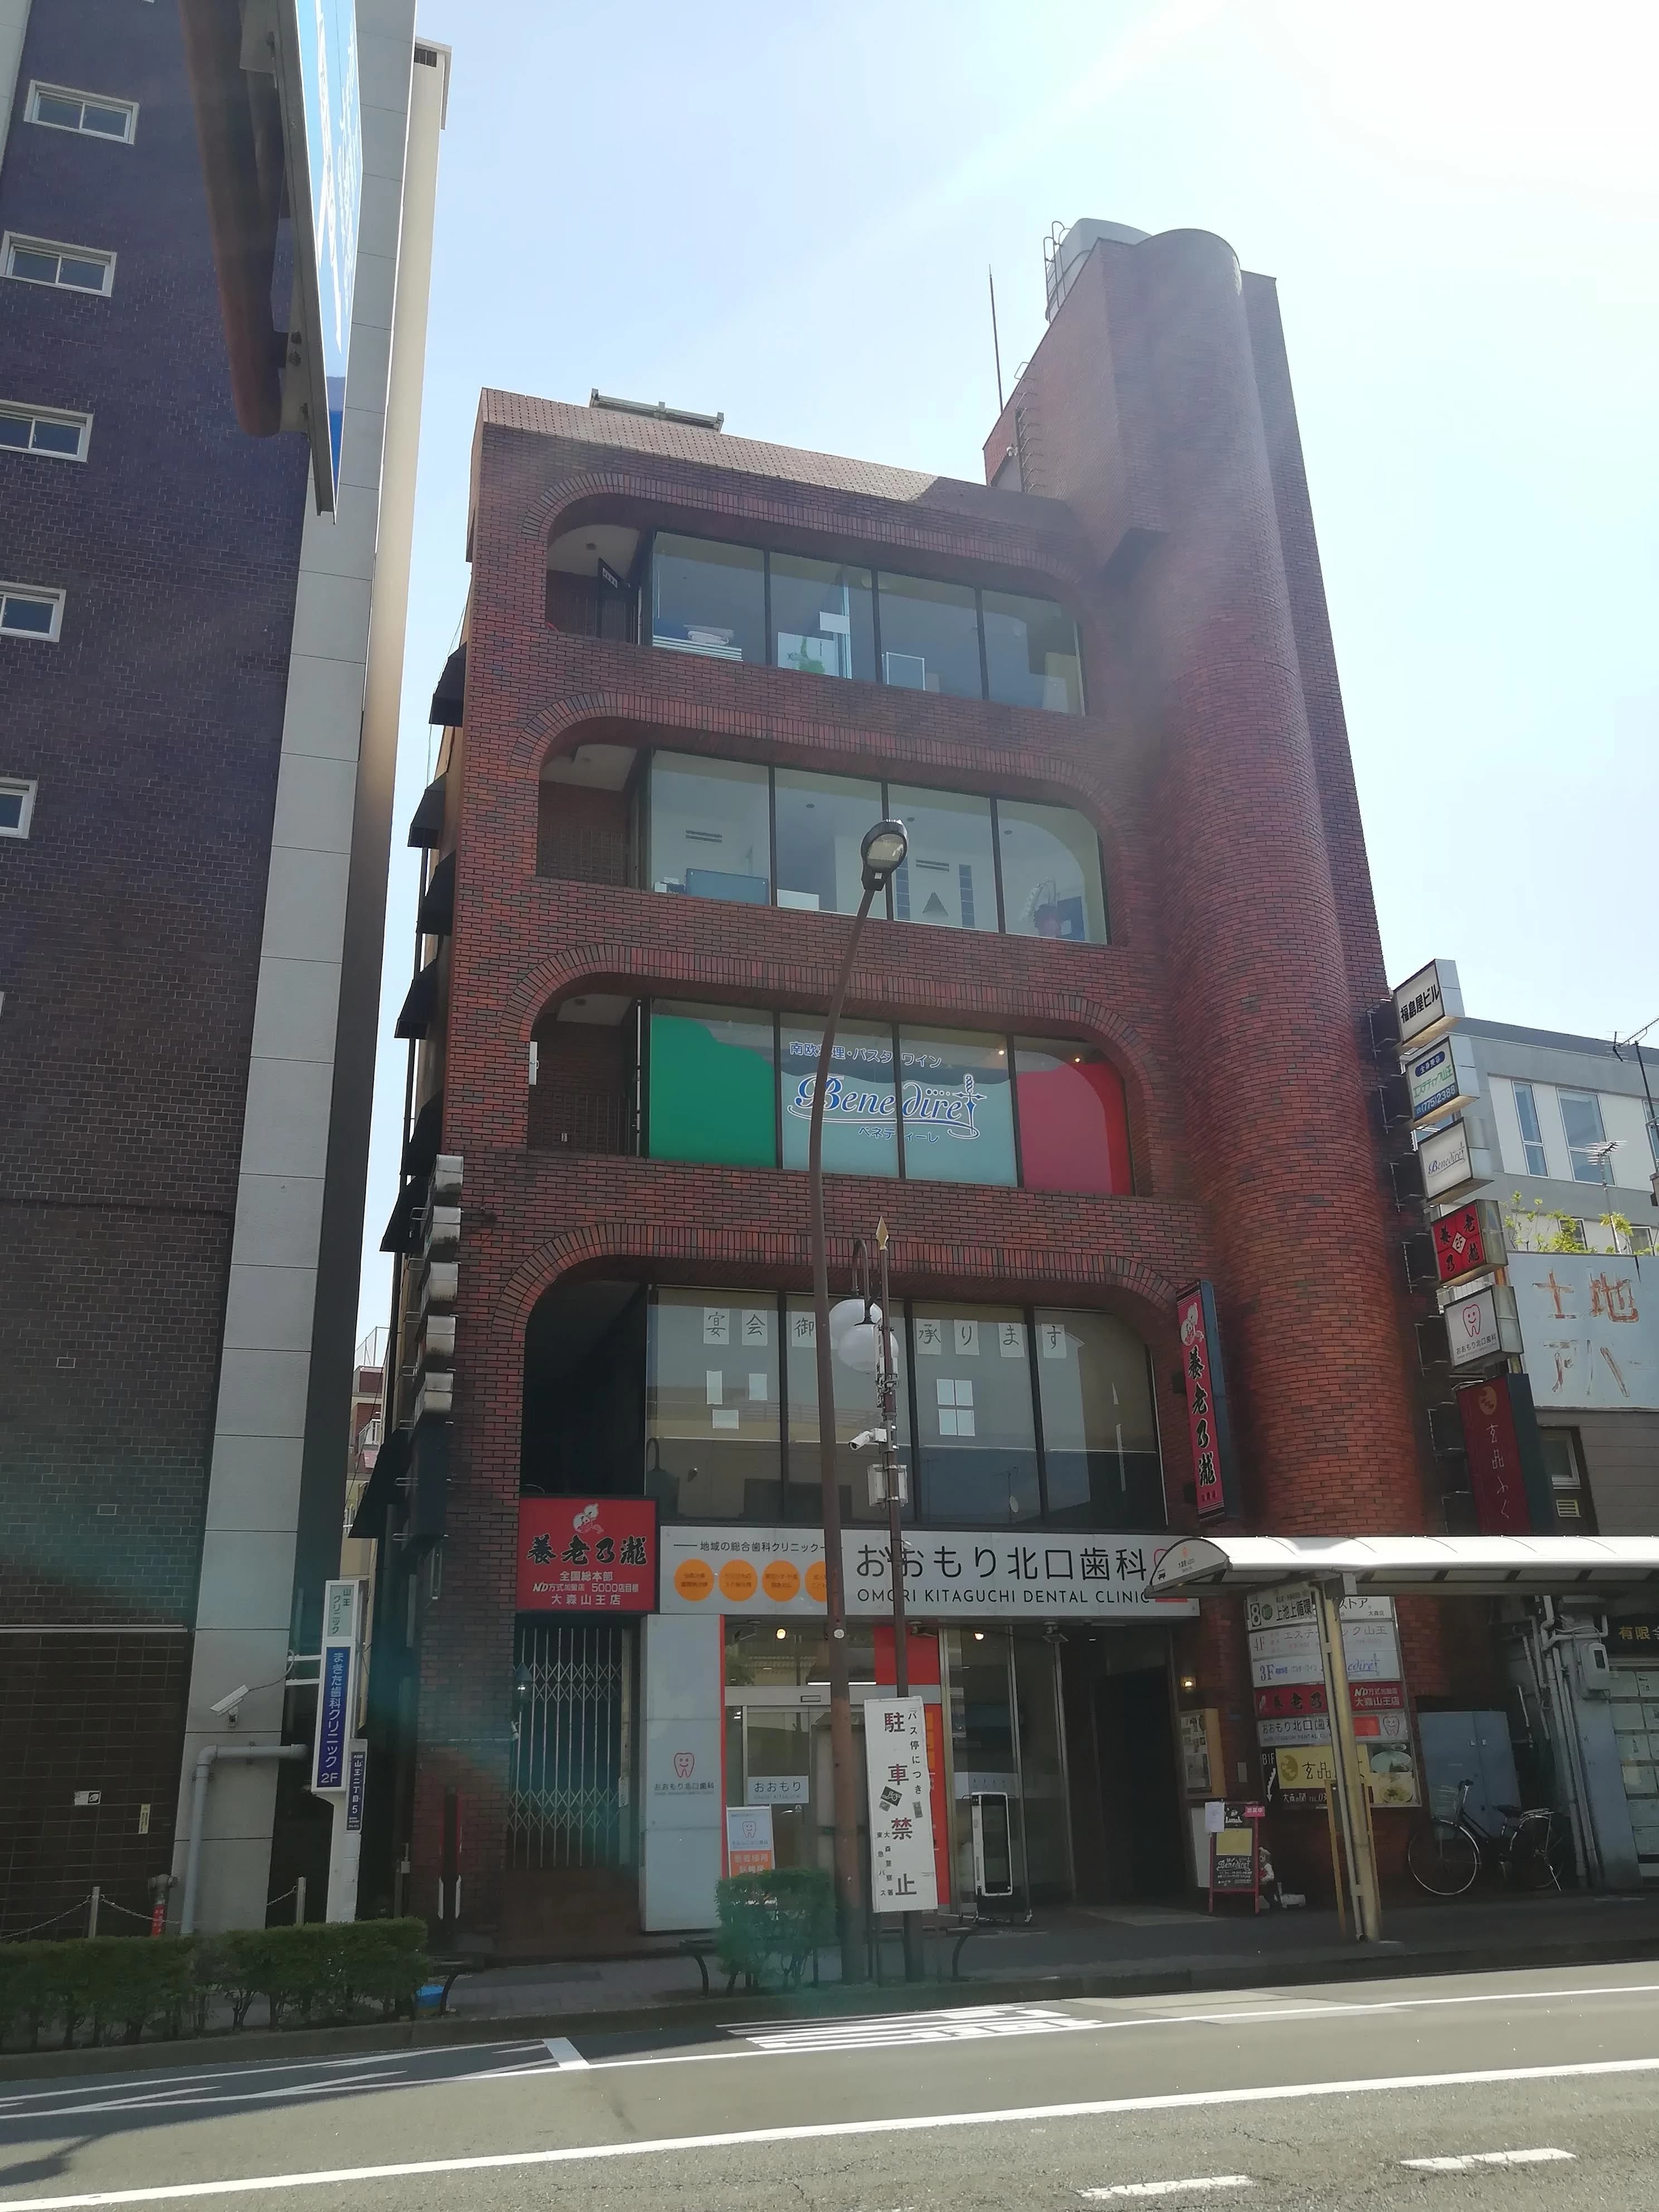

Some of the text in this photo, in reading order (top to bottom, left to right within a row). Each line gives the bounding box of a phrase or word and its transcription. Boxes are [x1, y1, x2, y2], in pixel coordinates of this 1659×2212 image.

[1400, 984, 1439, 1023] 福島屋ビル
[1455, 1236, 1463, 1250] 2F
[1532, 1267, 1639, 1323] 土地
[1187, 1345, 1217, 1487] 養老乃瀧
[526, 1534, 648, 1565] 養老乃瀧
[700, 1541, 818, 1553] 地域の総合歯科クリニック
[856, 1544, 1147, 1582] おおもり北口歯科
[560, 1570, 613, 1582] 全国総本部
[343, 1588, 351, 1607] 山王
[551, 1594, 621, 1605] 大森山王店
[925, 1589, 1015, 1603] KITAGUCHI
[1024, 1590, 1088, 1603] DENTAL
[1095, 1590, 1150, 1604] CLINIC
[332, 1595, 341, 1635] クリニック
[1260, 1663, 1274, 1681] 3F
[1273, 1691, 1323, 1709] 養老乃
[326, 1652, 344, 1768] まきた歯科クリニック
[908, 1711, 921, 1794] バス停につき
[1262, 1753, 1275, 1765] B1F
[321, 1773, 338, 1784] 2F
[754, 1781, 801, 1793] おおもり
[884, 1712, 917, 1895] 駐車禁止
